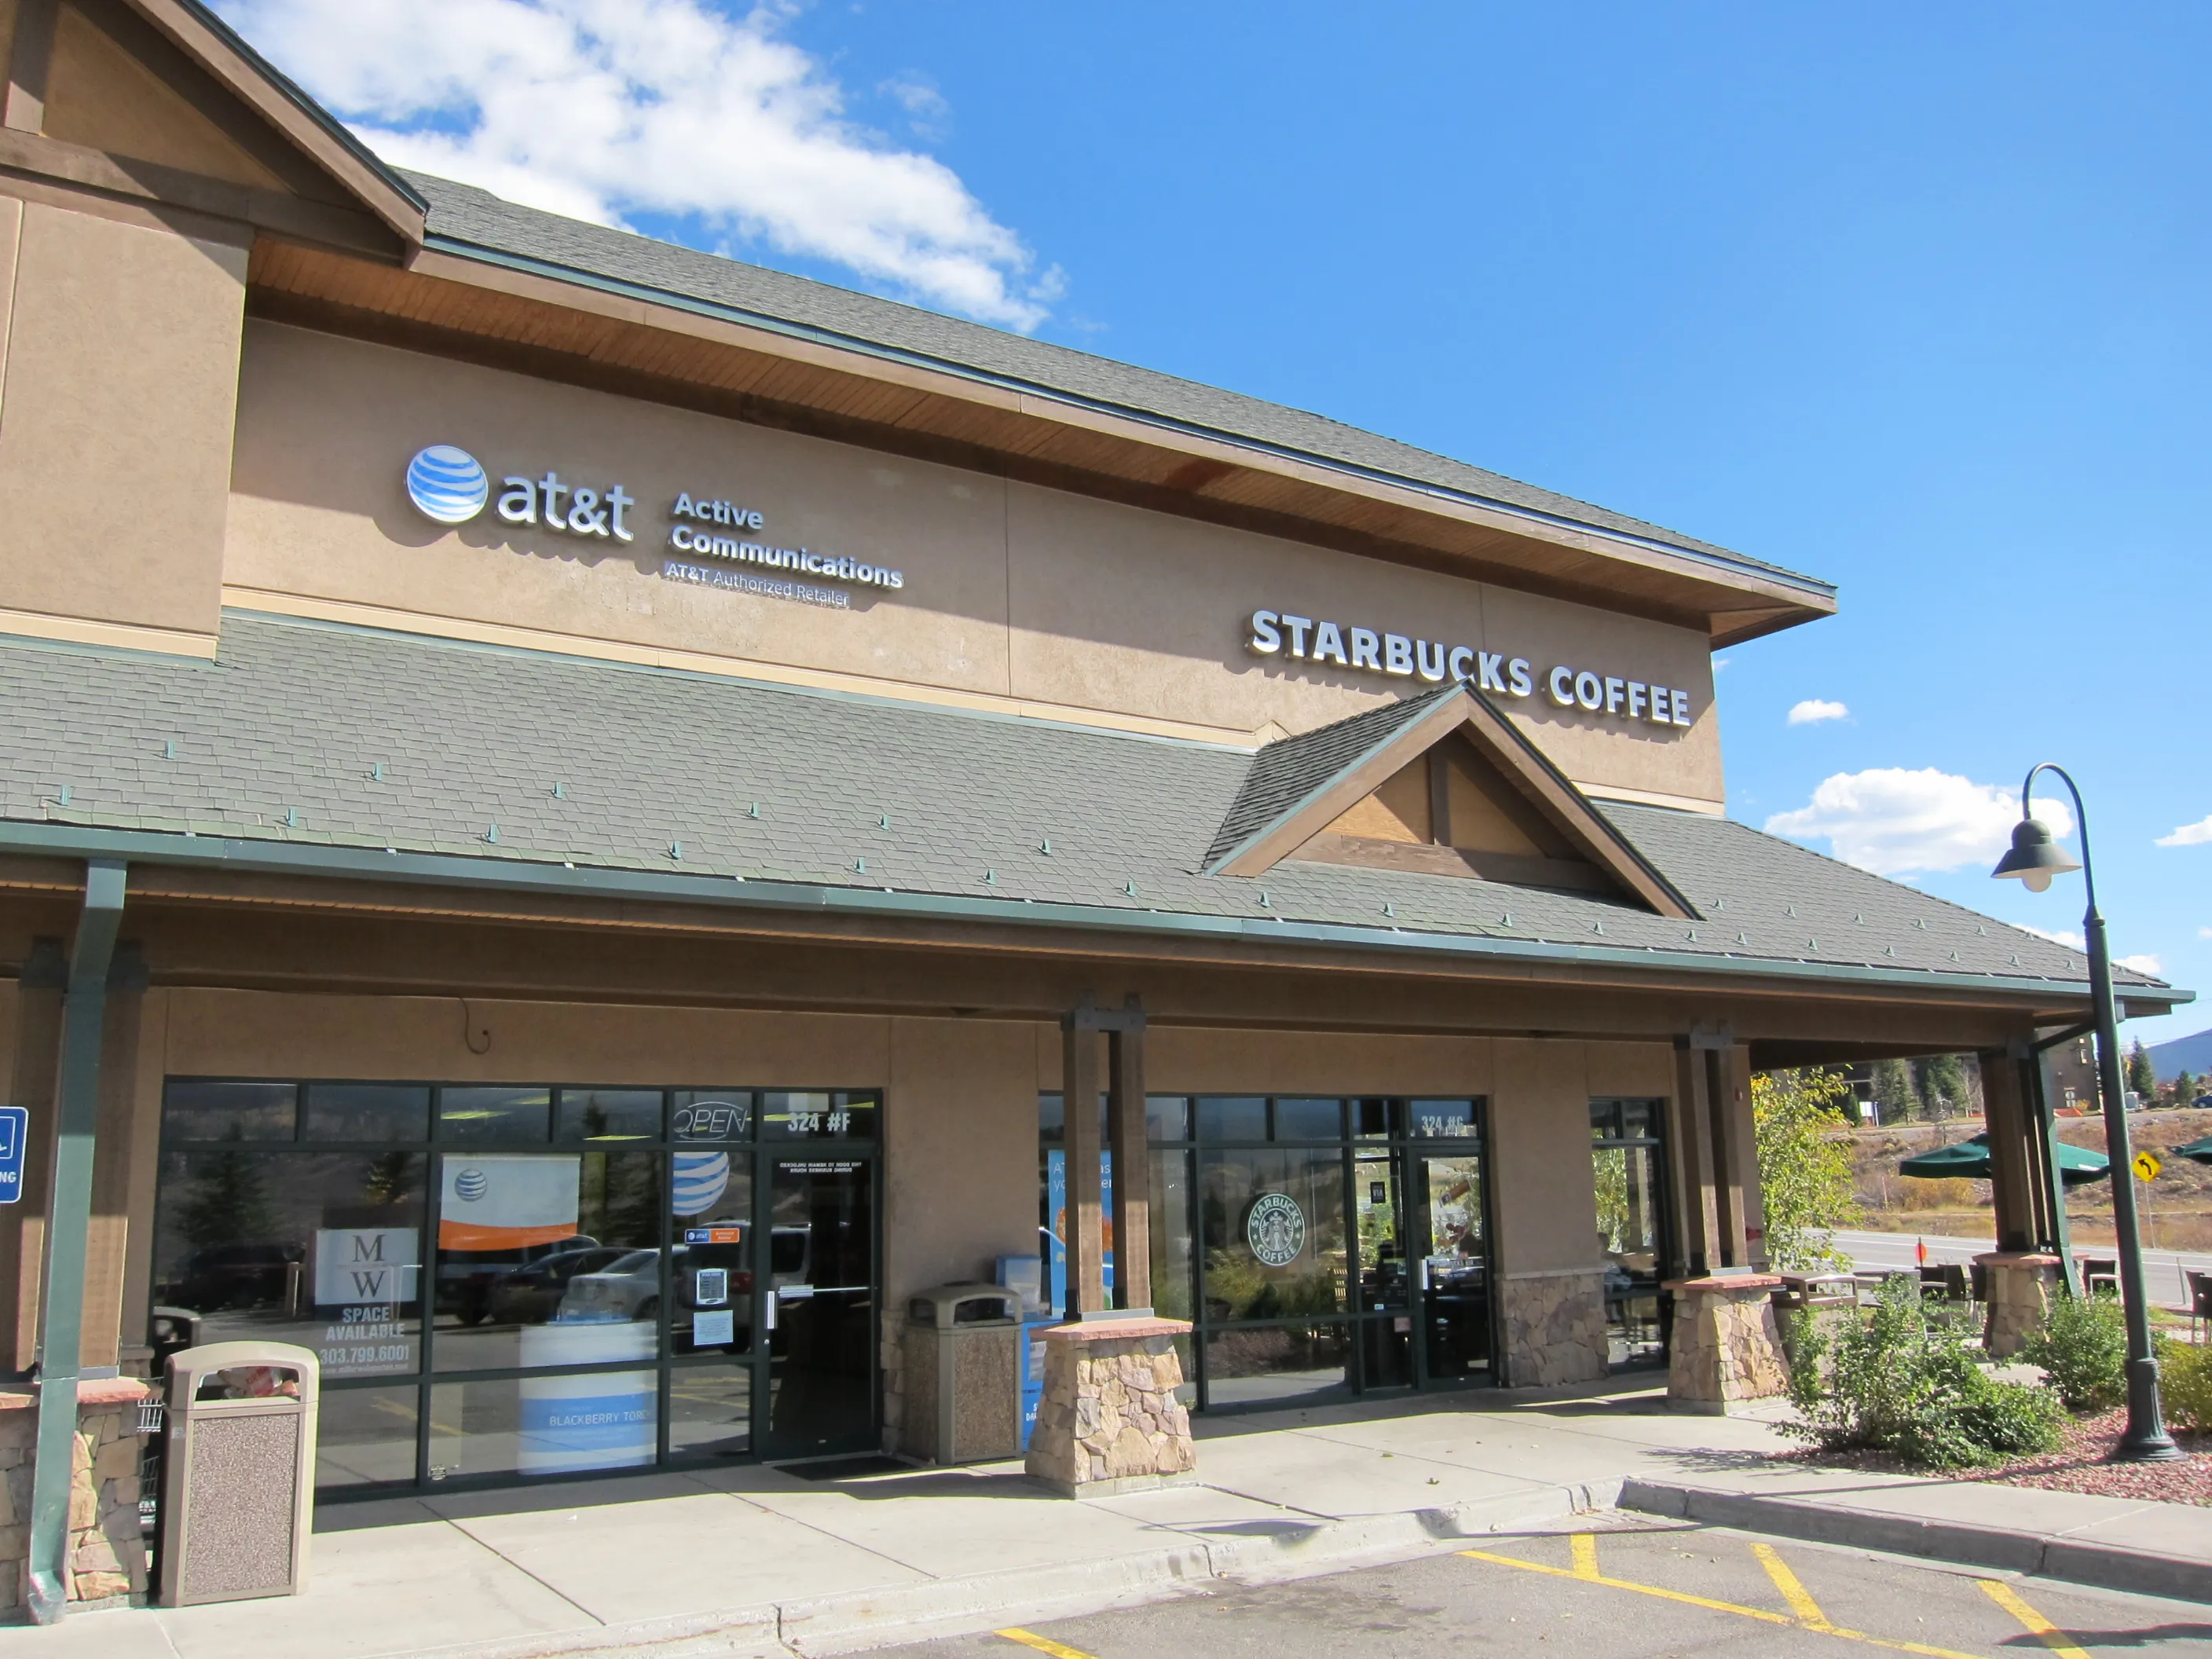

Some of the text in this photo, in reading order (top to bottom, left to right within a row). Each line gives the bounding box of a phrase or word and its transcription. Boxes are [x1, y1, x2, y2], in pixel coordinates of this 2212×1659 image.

[496, 471, 635, 542] at&t
[672, 492, 764, 530] Active
[672, 525, 904, 589] Communications
[666, 562, 850, 607] AT&T Authorized Retailer
[1251, 610, 1692, 727] STARBUCKS COFFEE
[673, 1109, 748, 1133] OPEN
[787, 1112, 851, 1132] 324 #F
[1421, 1115, 1442, 1131] 324
[1251, 1196, 1302, 1229] STARBUCKS
[351, 1233, 386, 1262] M
[1256, 1243, 1297, 1262] COFFEE
[350, 1270, 387, 1298] W
[342, 1306, 390, 1324] SPACE
[325, 1323, 405, 1342] AVAILABLE
[549, 1410, 648, 1426] BLACKBERRY TORC
